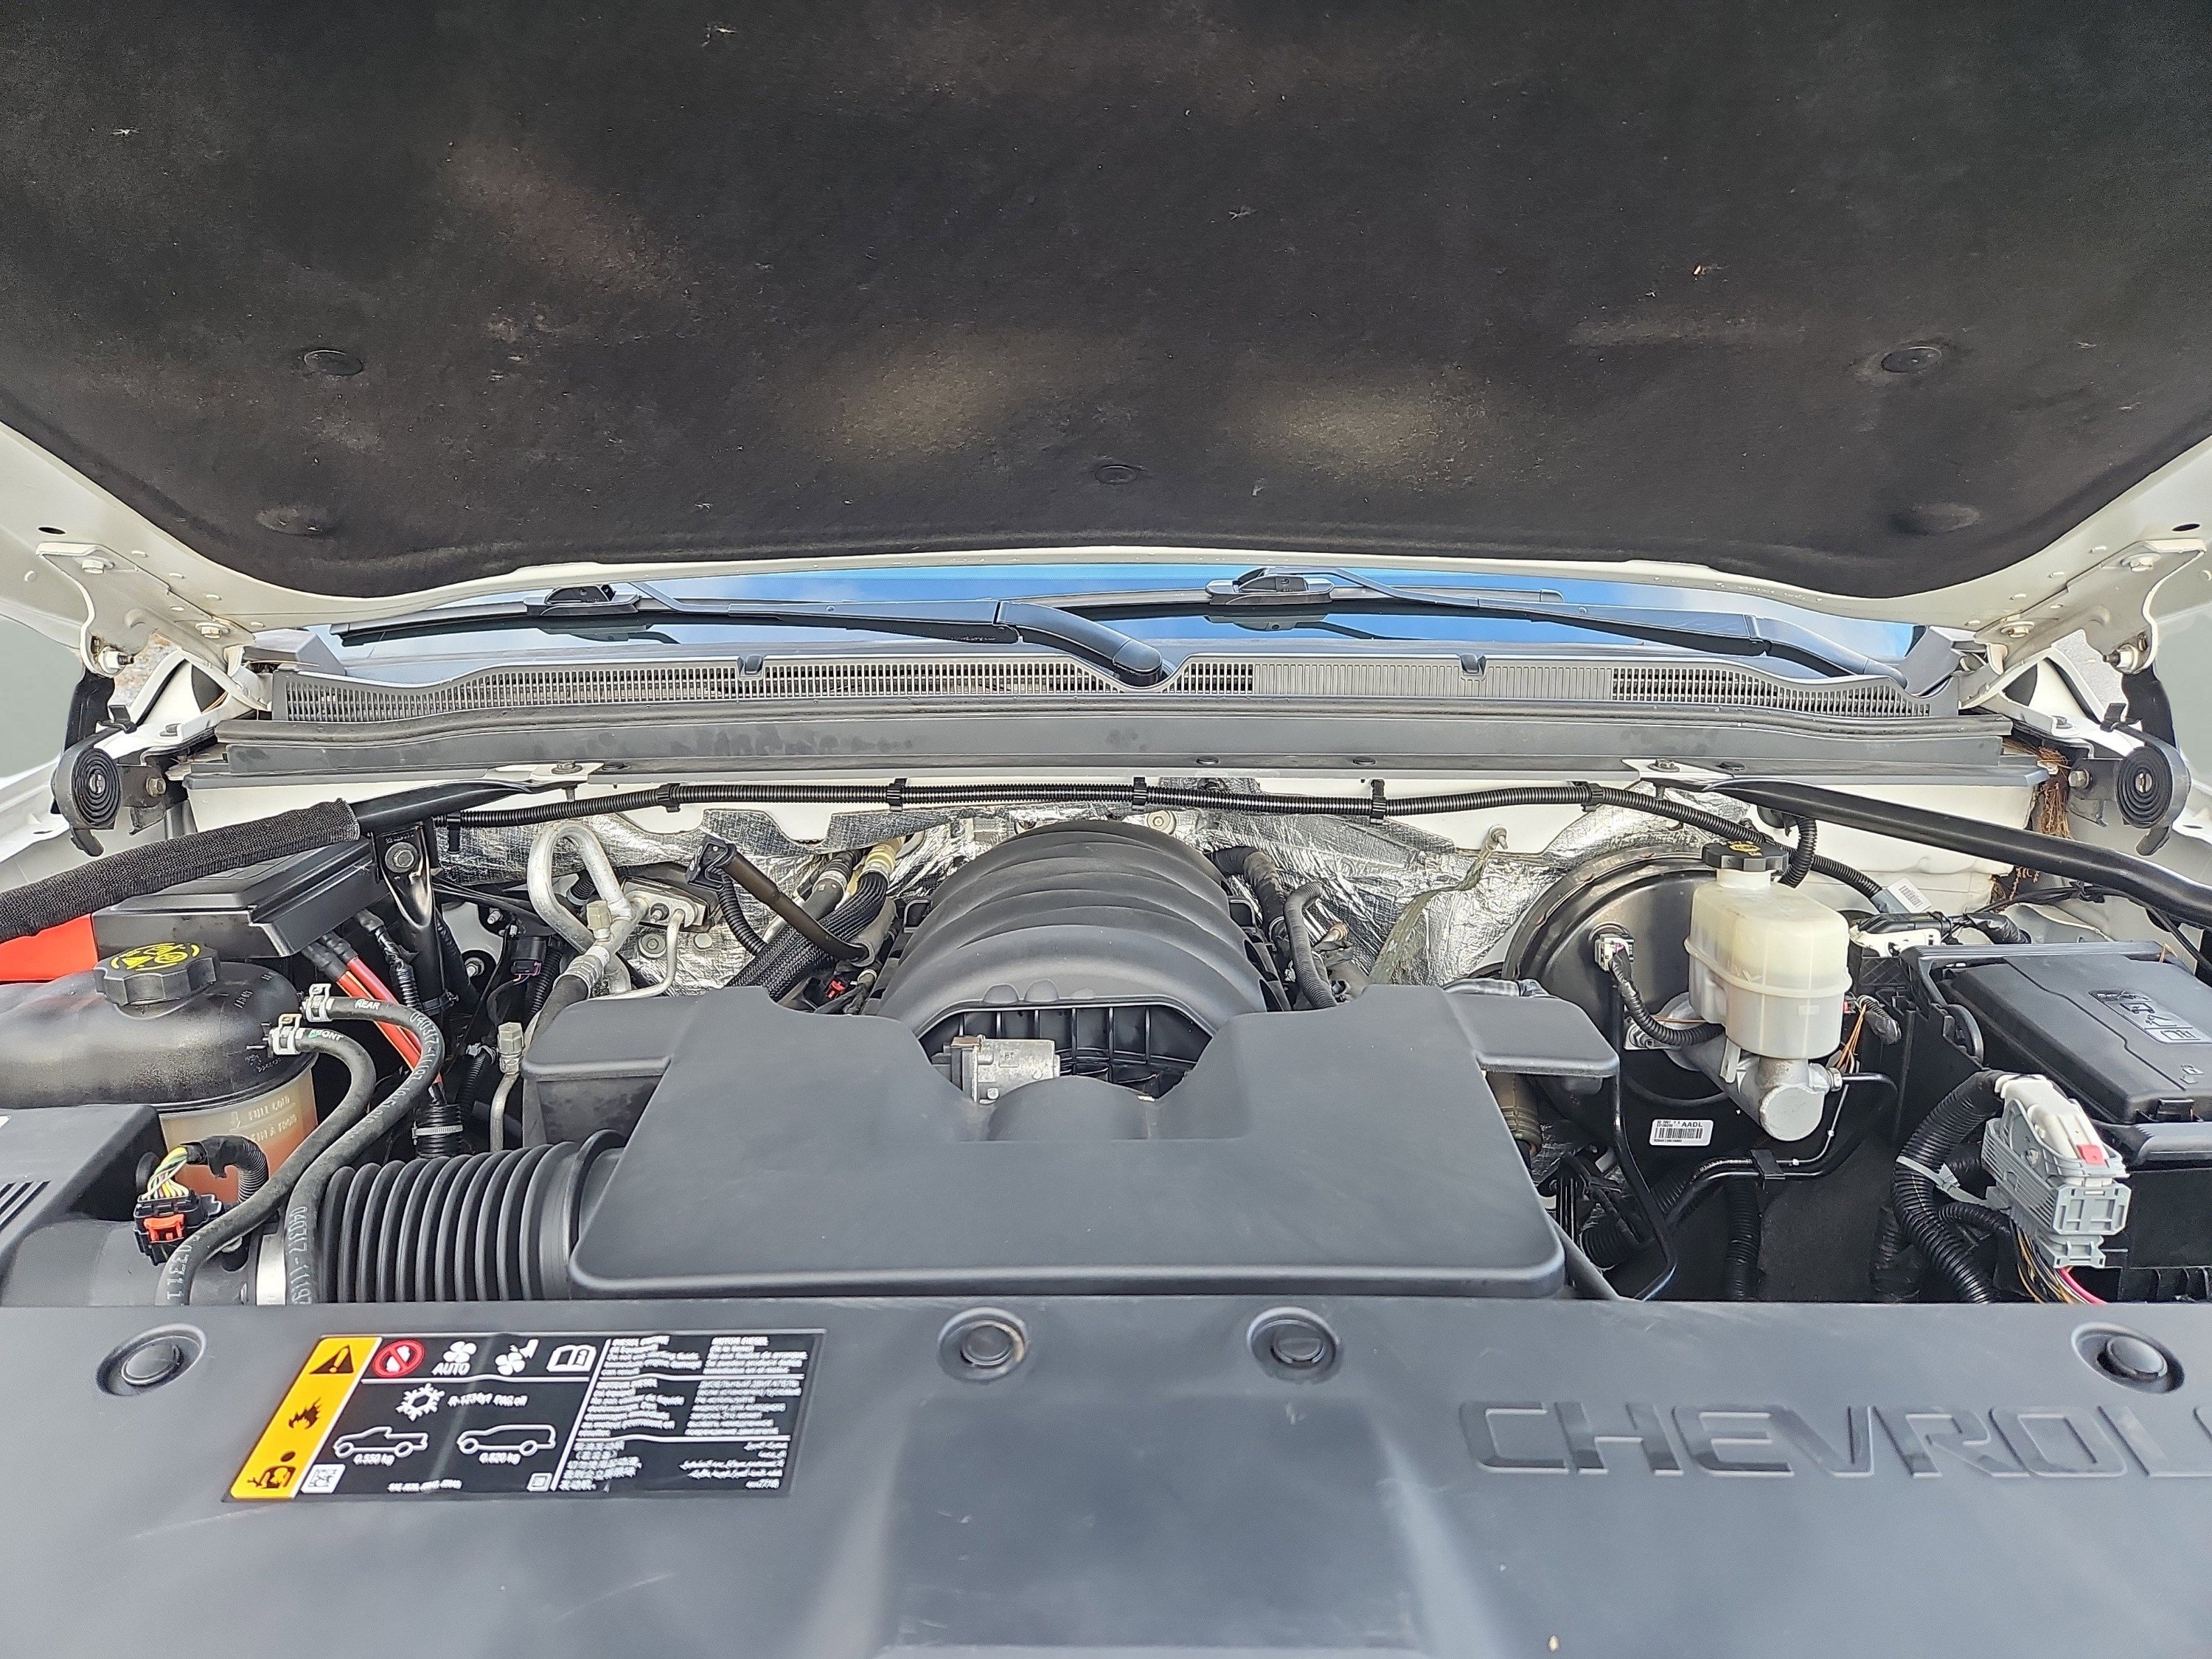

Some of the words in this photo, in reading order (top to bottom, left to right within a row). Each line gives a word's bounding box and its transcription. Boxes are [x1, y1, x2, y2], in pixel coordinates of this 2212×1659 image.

[355, 998, 380, 1010] REAR
[431, 1362, 470, 1376] AUTO
[1459, 1400, 2212, 1478] CHEVROL
